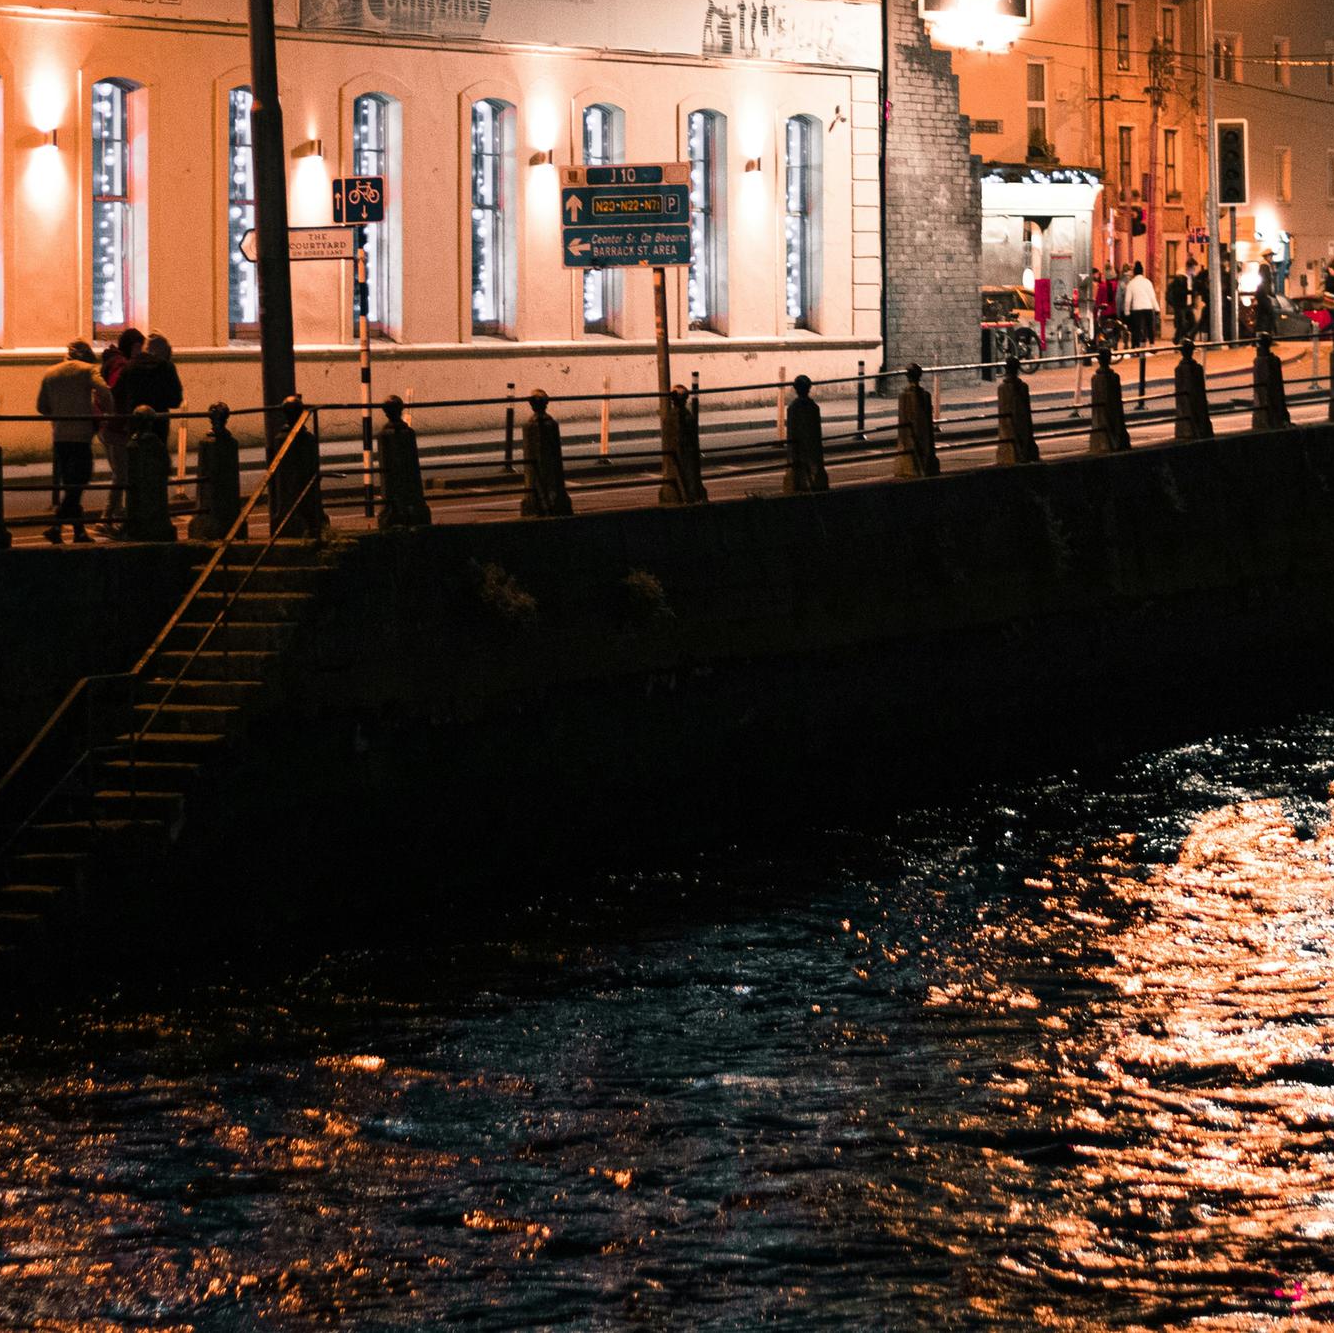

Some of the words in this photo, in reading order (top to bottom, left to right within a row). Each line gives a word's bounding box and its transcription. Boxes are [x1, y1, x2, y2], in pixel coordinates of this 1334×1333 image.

[668, 197, 676, 211] P
[593, 246, 635, 257] BARRACK
[637, 246, 651, 256] ST.
[653, 245, 677, 255] AREA
